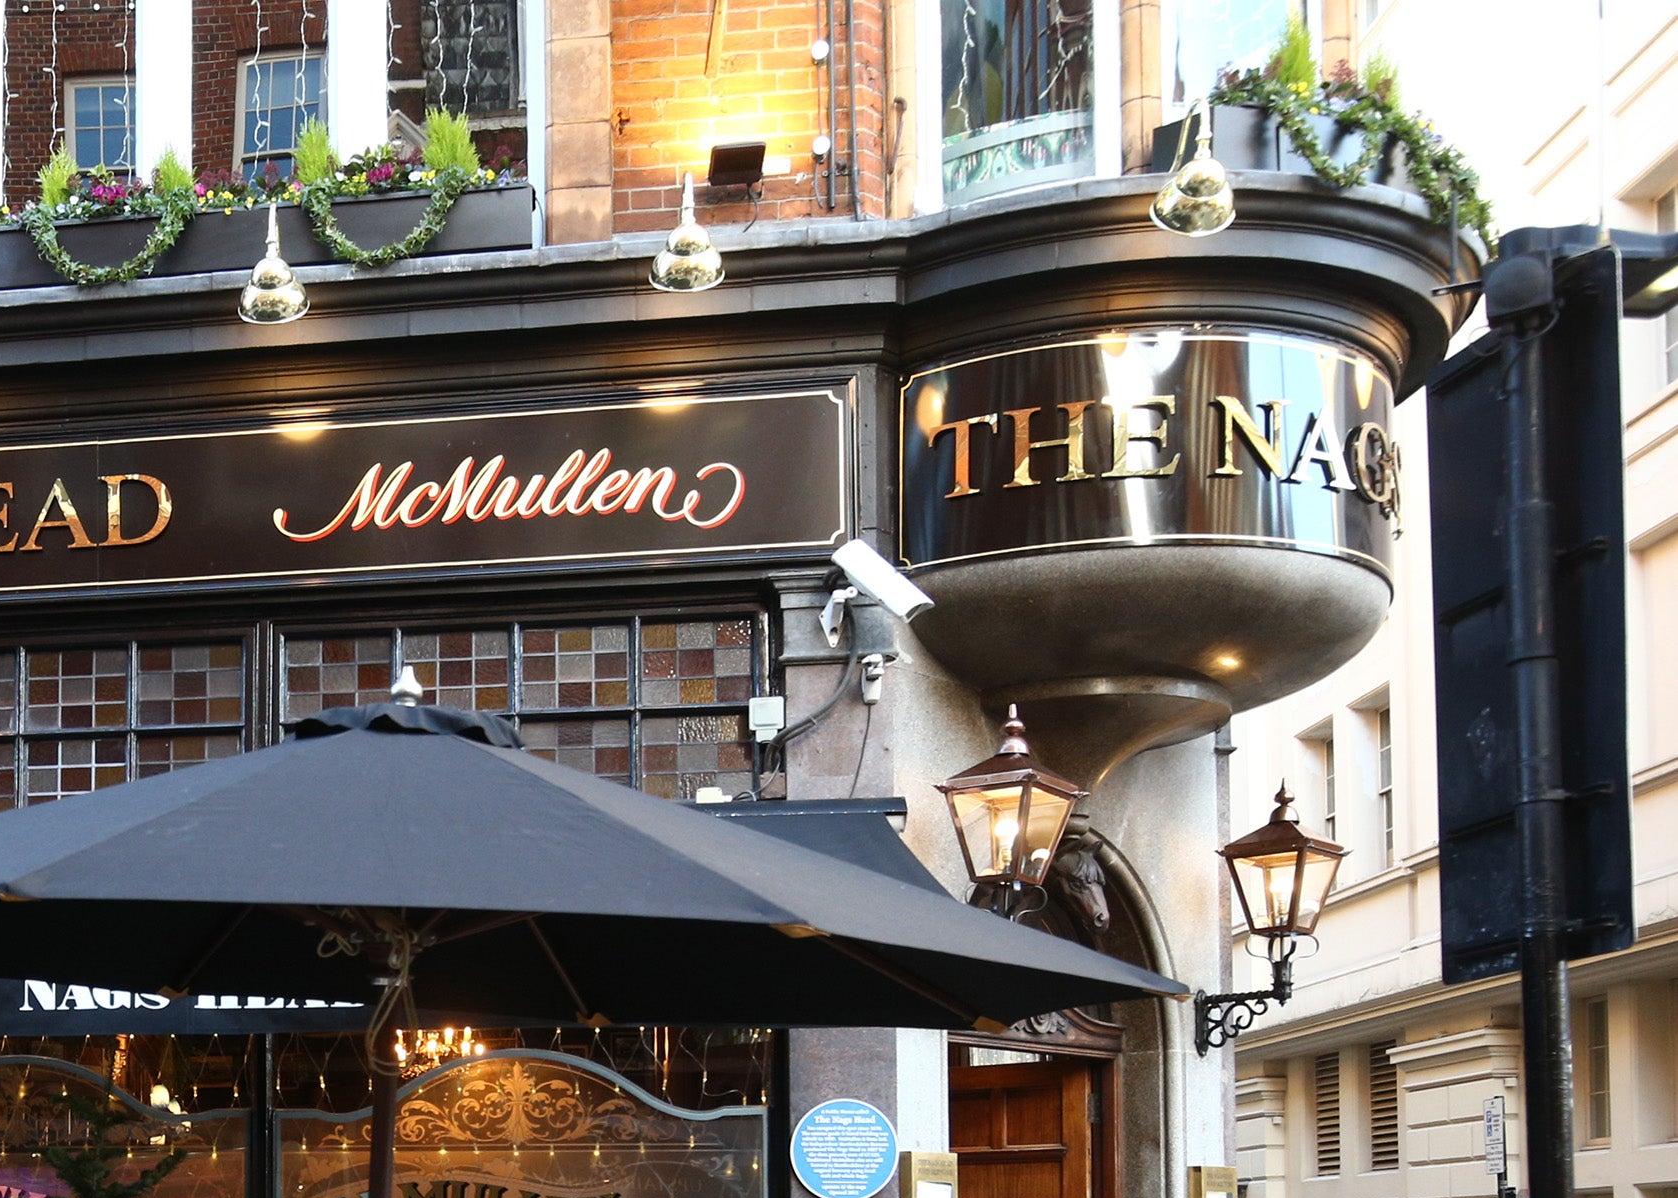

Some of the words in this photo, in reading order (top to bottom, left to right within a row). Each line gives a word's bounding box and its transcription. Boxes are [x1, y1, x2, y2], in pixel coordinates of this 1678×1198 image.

[928, 393, 1181, 500] THE
[273, 448, 745, 542] McMullen
[814, 1115, 831, 1124] The
[832, 1115, 853, 1126] Nags
[853, 1115, 876, 1124] Head
